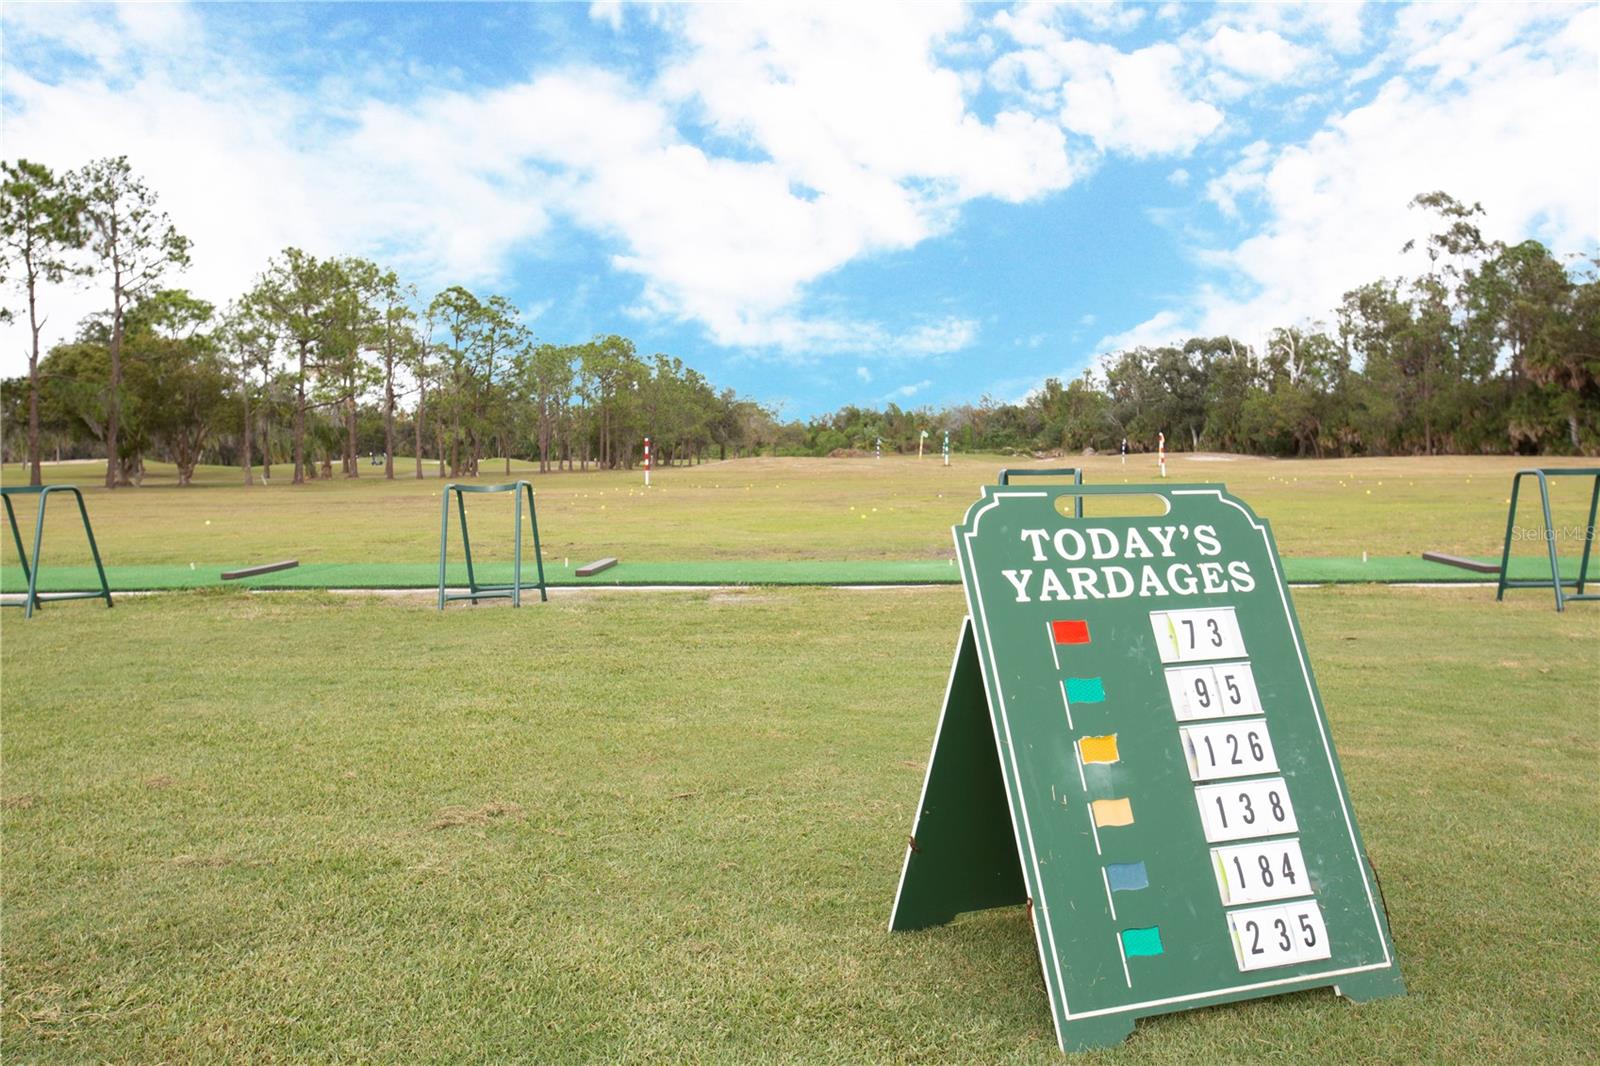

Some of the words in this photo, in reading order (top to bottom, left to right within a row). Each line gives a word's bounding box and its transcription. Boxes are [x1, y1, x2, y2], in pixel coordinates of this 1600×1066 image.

[1021, 524, 1222, 561] TODAY'S
[1001, 561, 1256, 602] YARDAGES
[1182, 618, 1223, 649] 73
[1194, 675, 1241, 708] 95
[1204, 731, 1264, 767] 126
[1216, 791, 1285, 828] 138
[1233, 852, 1296, 889] 184
[1246, 914, 1316, 955] 235
